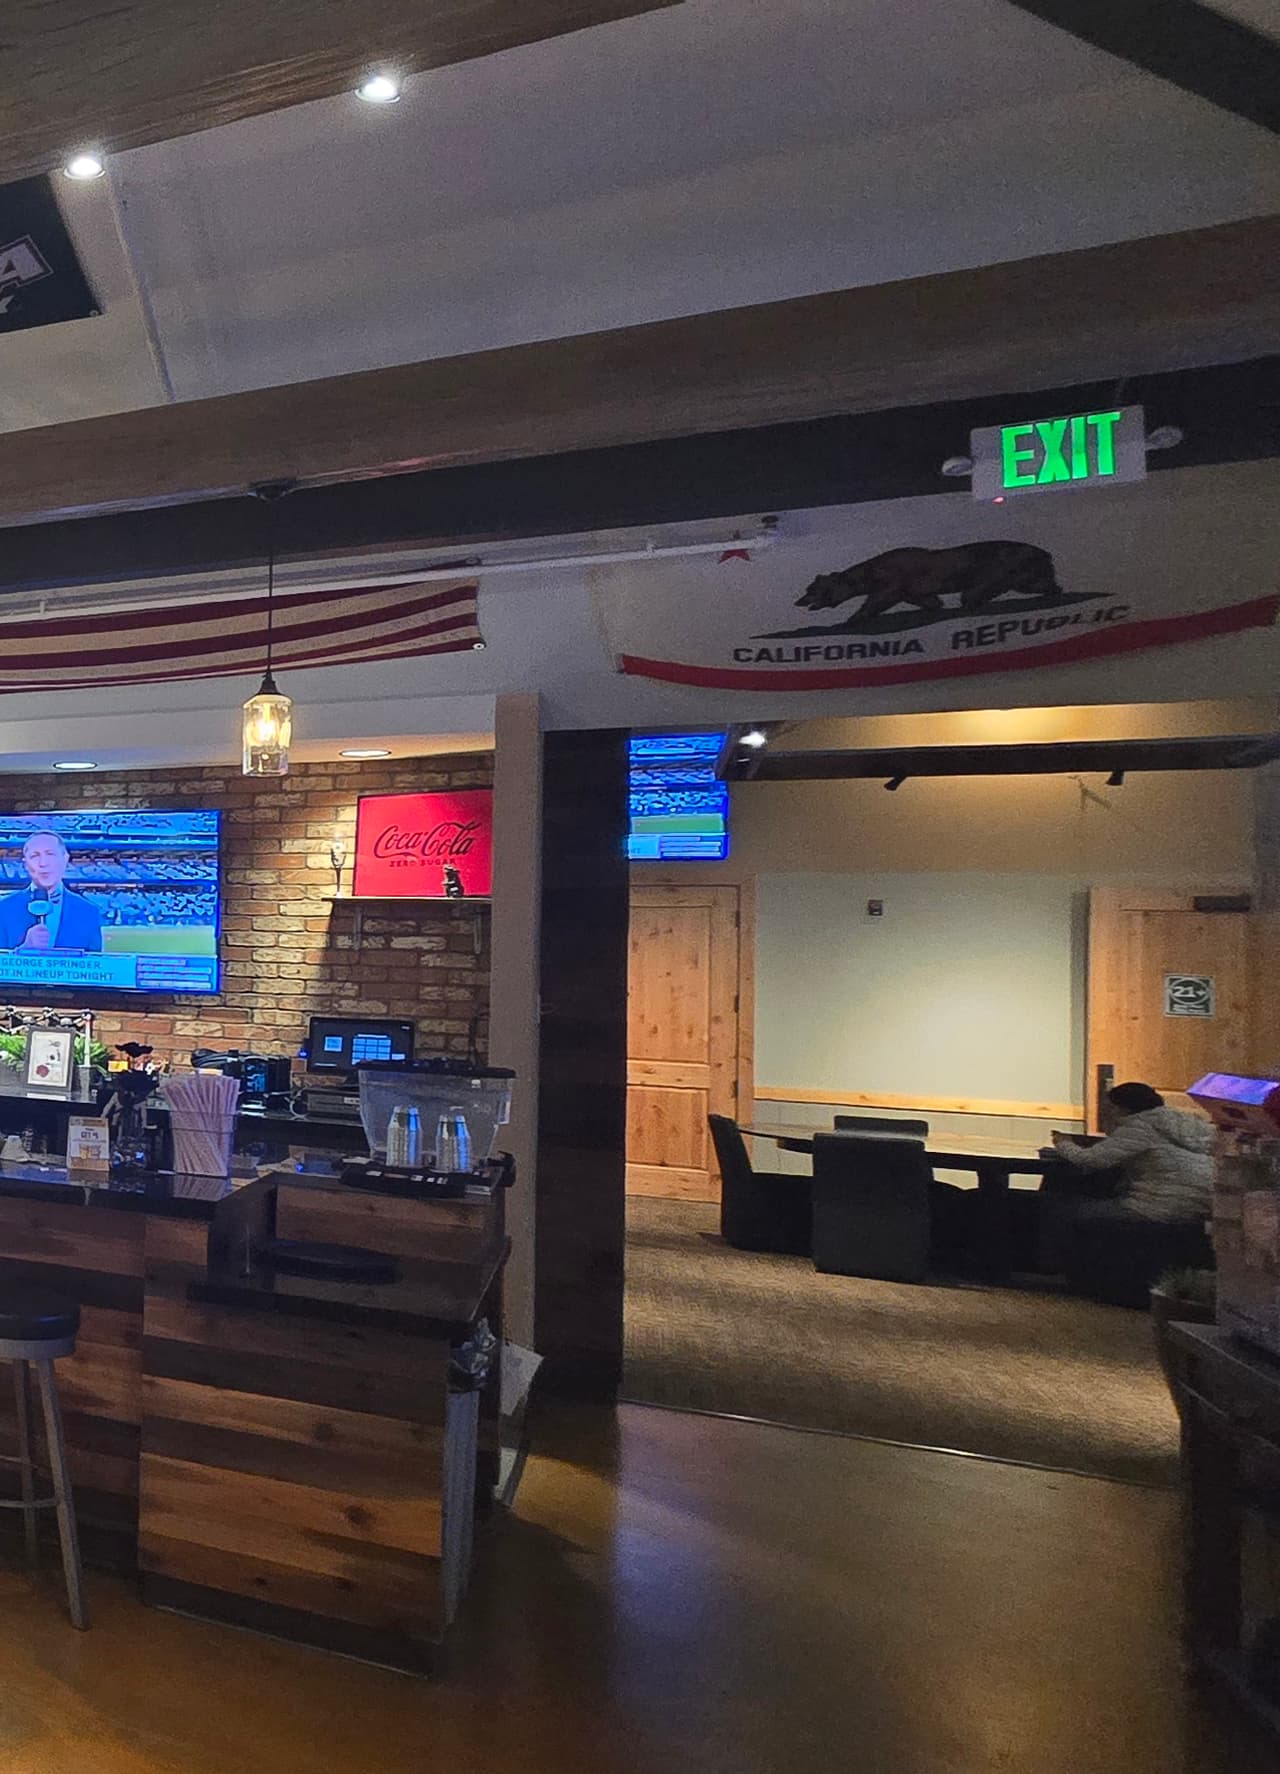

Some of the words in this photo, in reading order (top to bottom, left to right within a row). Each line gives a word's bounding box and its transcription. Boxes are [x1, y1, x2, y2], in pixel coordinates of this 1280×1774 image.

[1001, 412, 1121, 489] EXIT
[733, 638, 924, 663] CALIFORNIA
[951, 604, 1131, 650] REPUBLIC
[374, 820, 483, 858] Coca-Cola
[420, 858, 456, 867] SUGAR
[1, 957, 43, 967] GEORGE
[46, 958, 101, 969] SPRINGER
[13, 969, 22, 977] IN
[26, 969, 63, 979] LINEUP
[67, 970, 113, 980] TONIGHT
